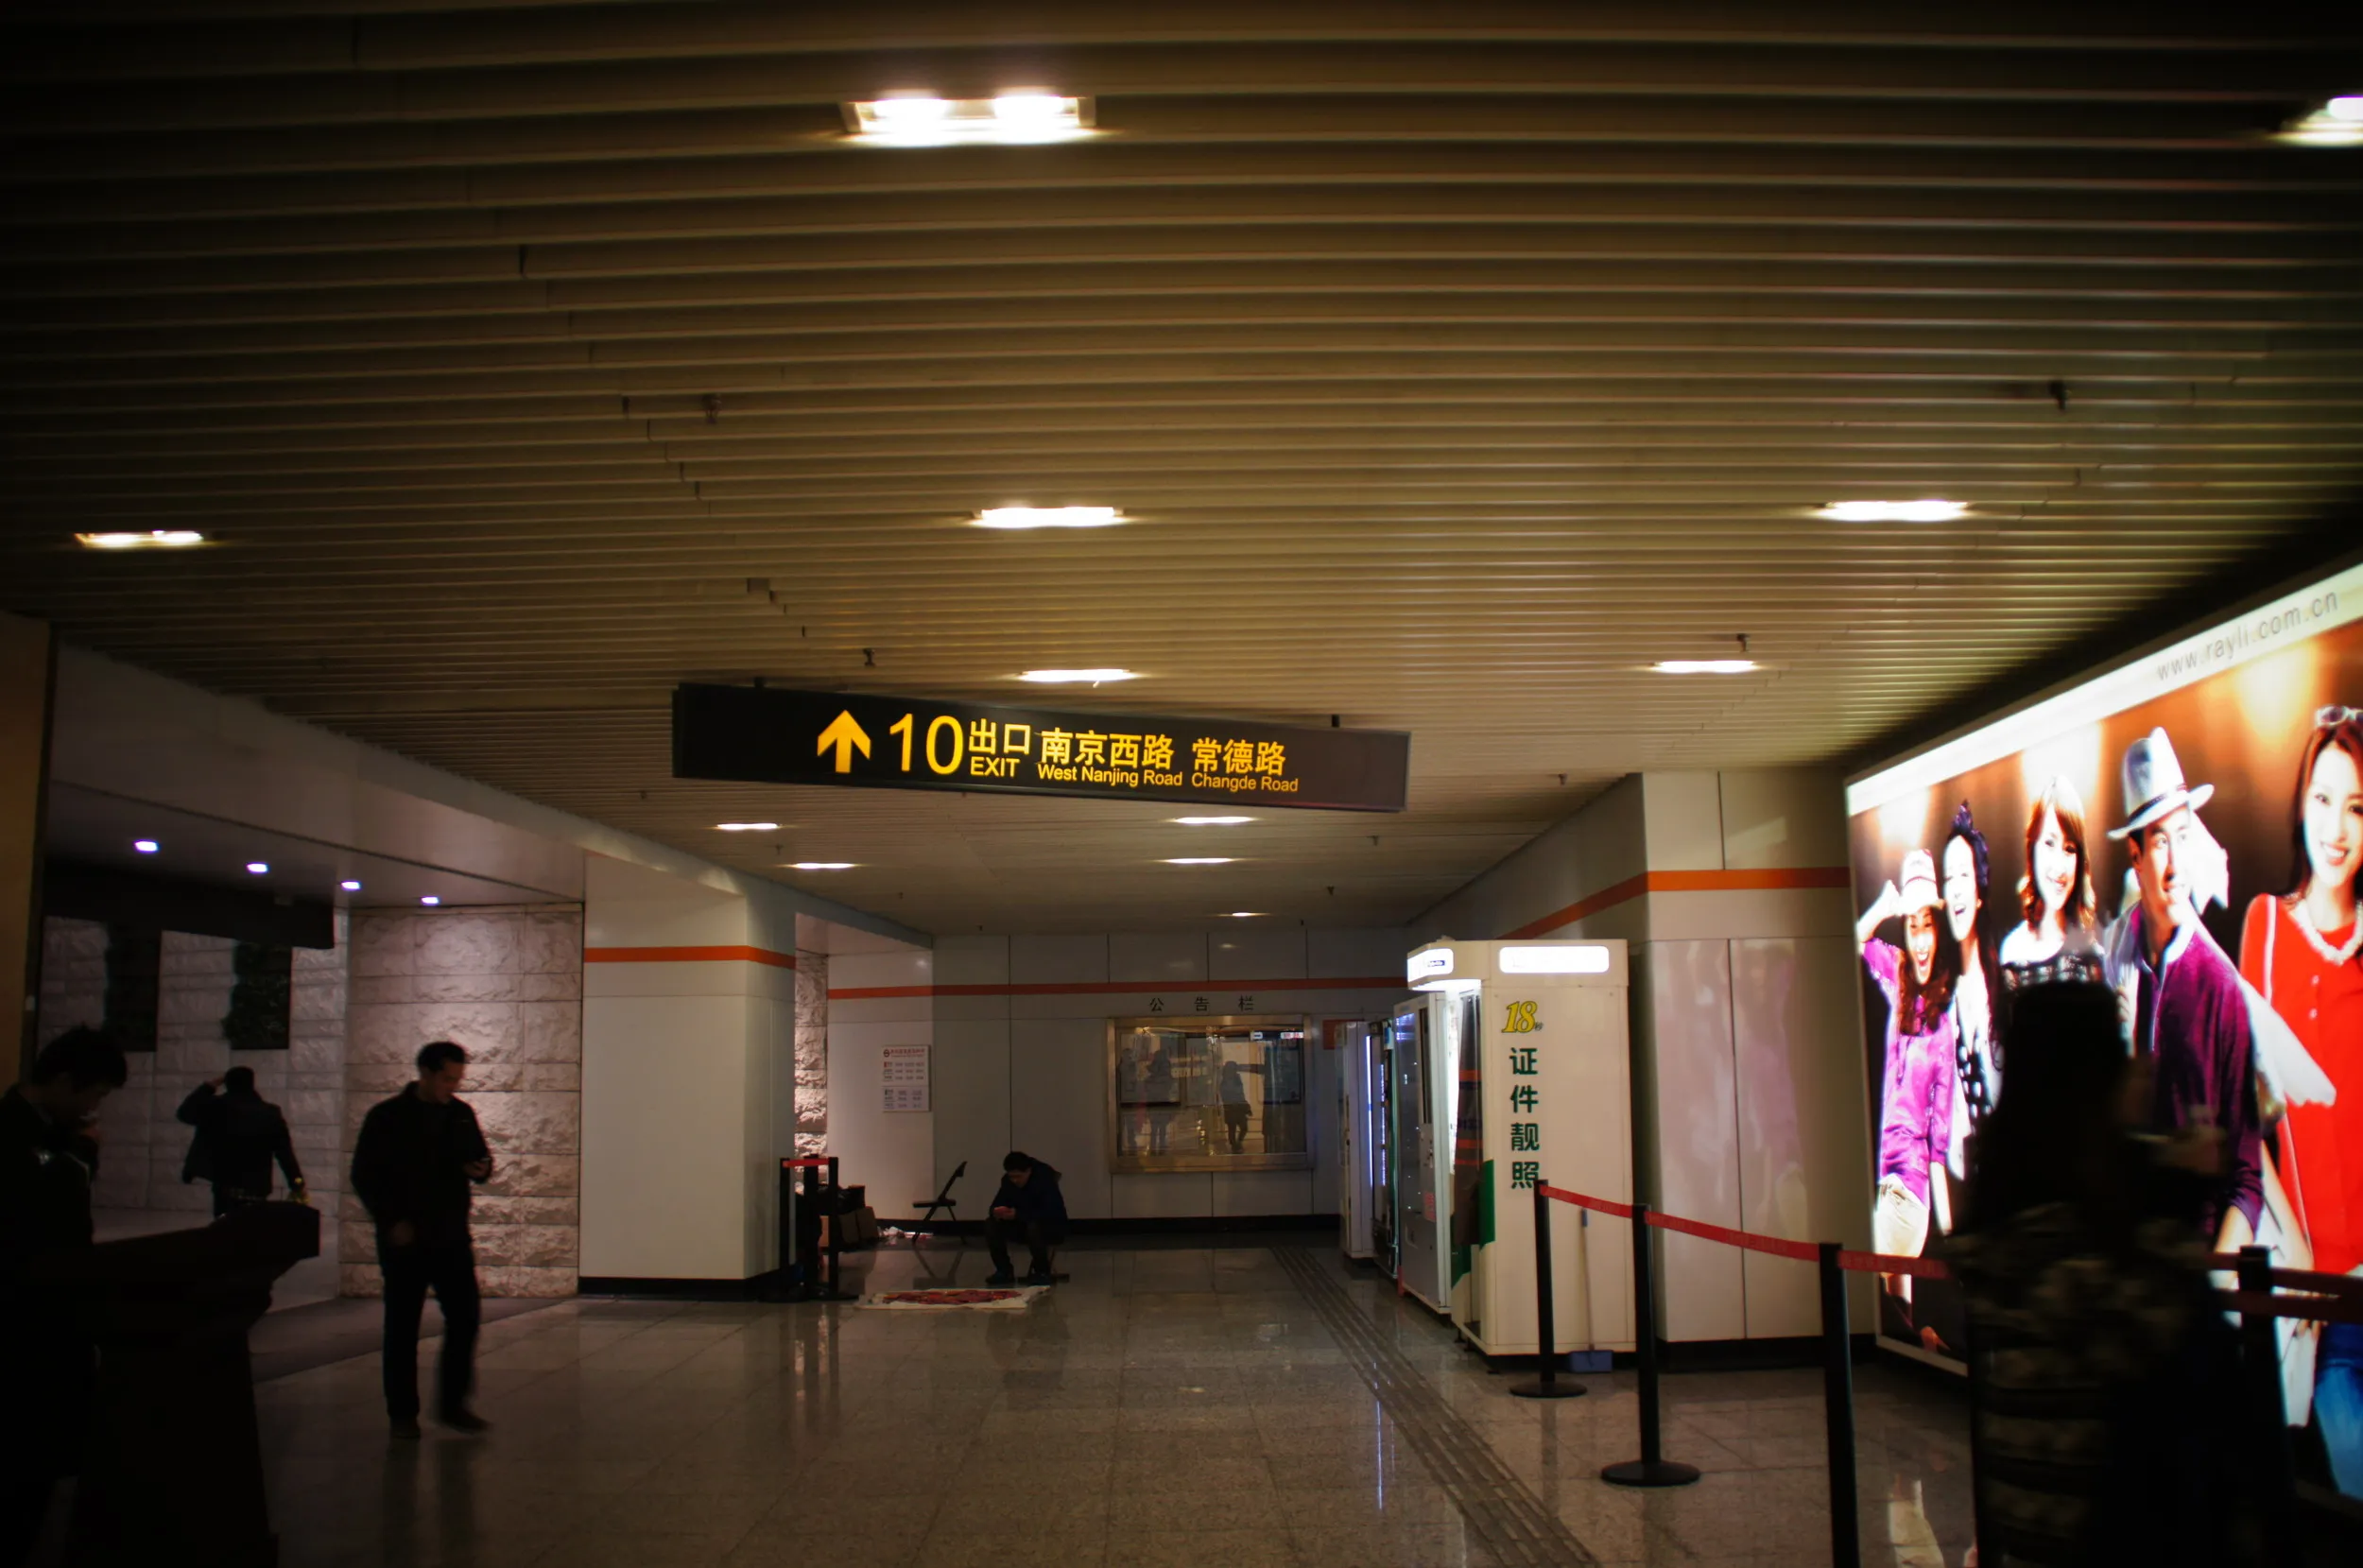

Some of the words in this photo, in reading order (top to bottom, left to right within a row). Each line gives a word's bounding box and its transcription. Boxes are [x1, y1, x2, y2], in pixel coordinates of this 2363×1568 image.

[2156, 592, 2338, 681] www.rayli.com.cn
[889, 713, 964, 775] 10
[968, 718, 1031, 755] 出口
[1040, 727, 1175, 770] 南京西路
[1192, 737, 1286, 776] 常德路
[970, 756, 1021, 778] EXIT
[1037, 764, 1078, 781] West
[1081, 766, 1139, 787] Nanjing
[1143, 769, 1183, 786] Road
[1191, 772, 1257, 793] Changde
[1261, 776, 1300, 792] Road
[1149, 994, 1254, 1012] 公告栏
[1509, 1047, 1540, 1190] 证件靓照
